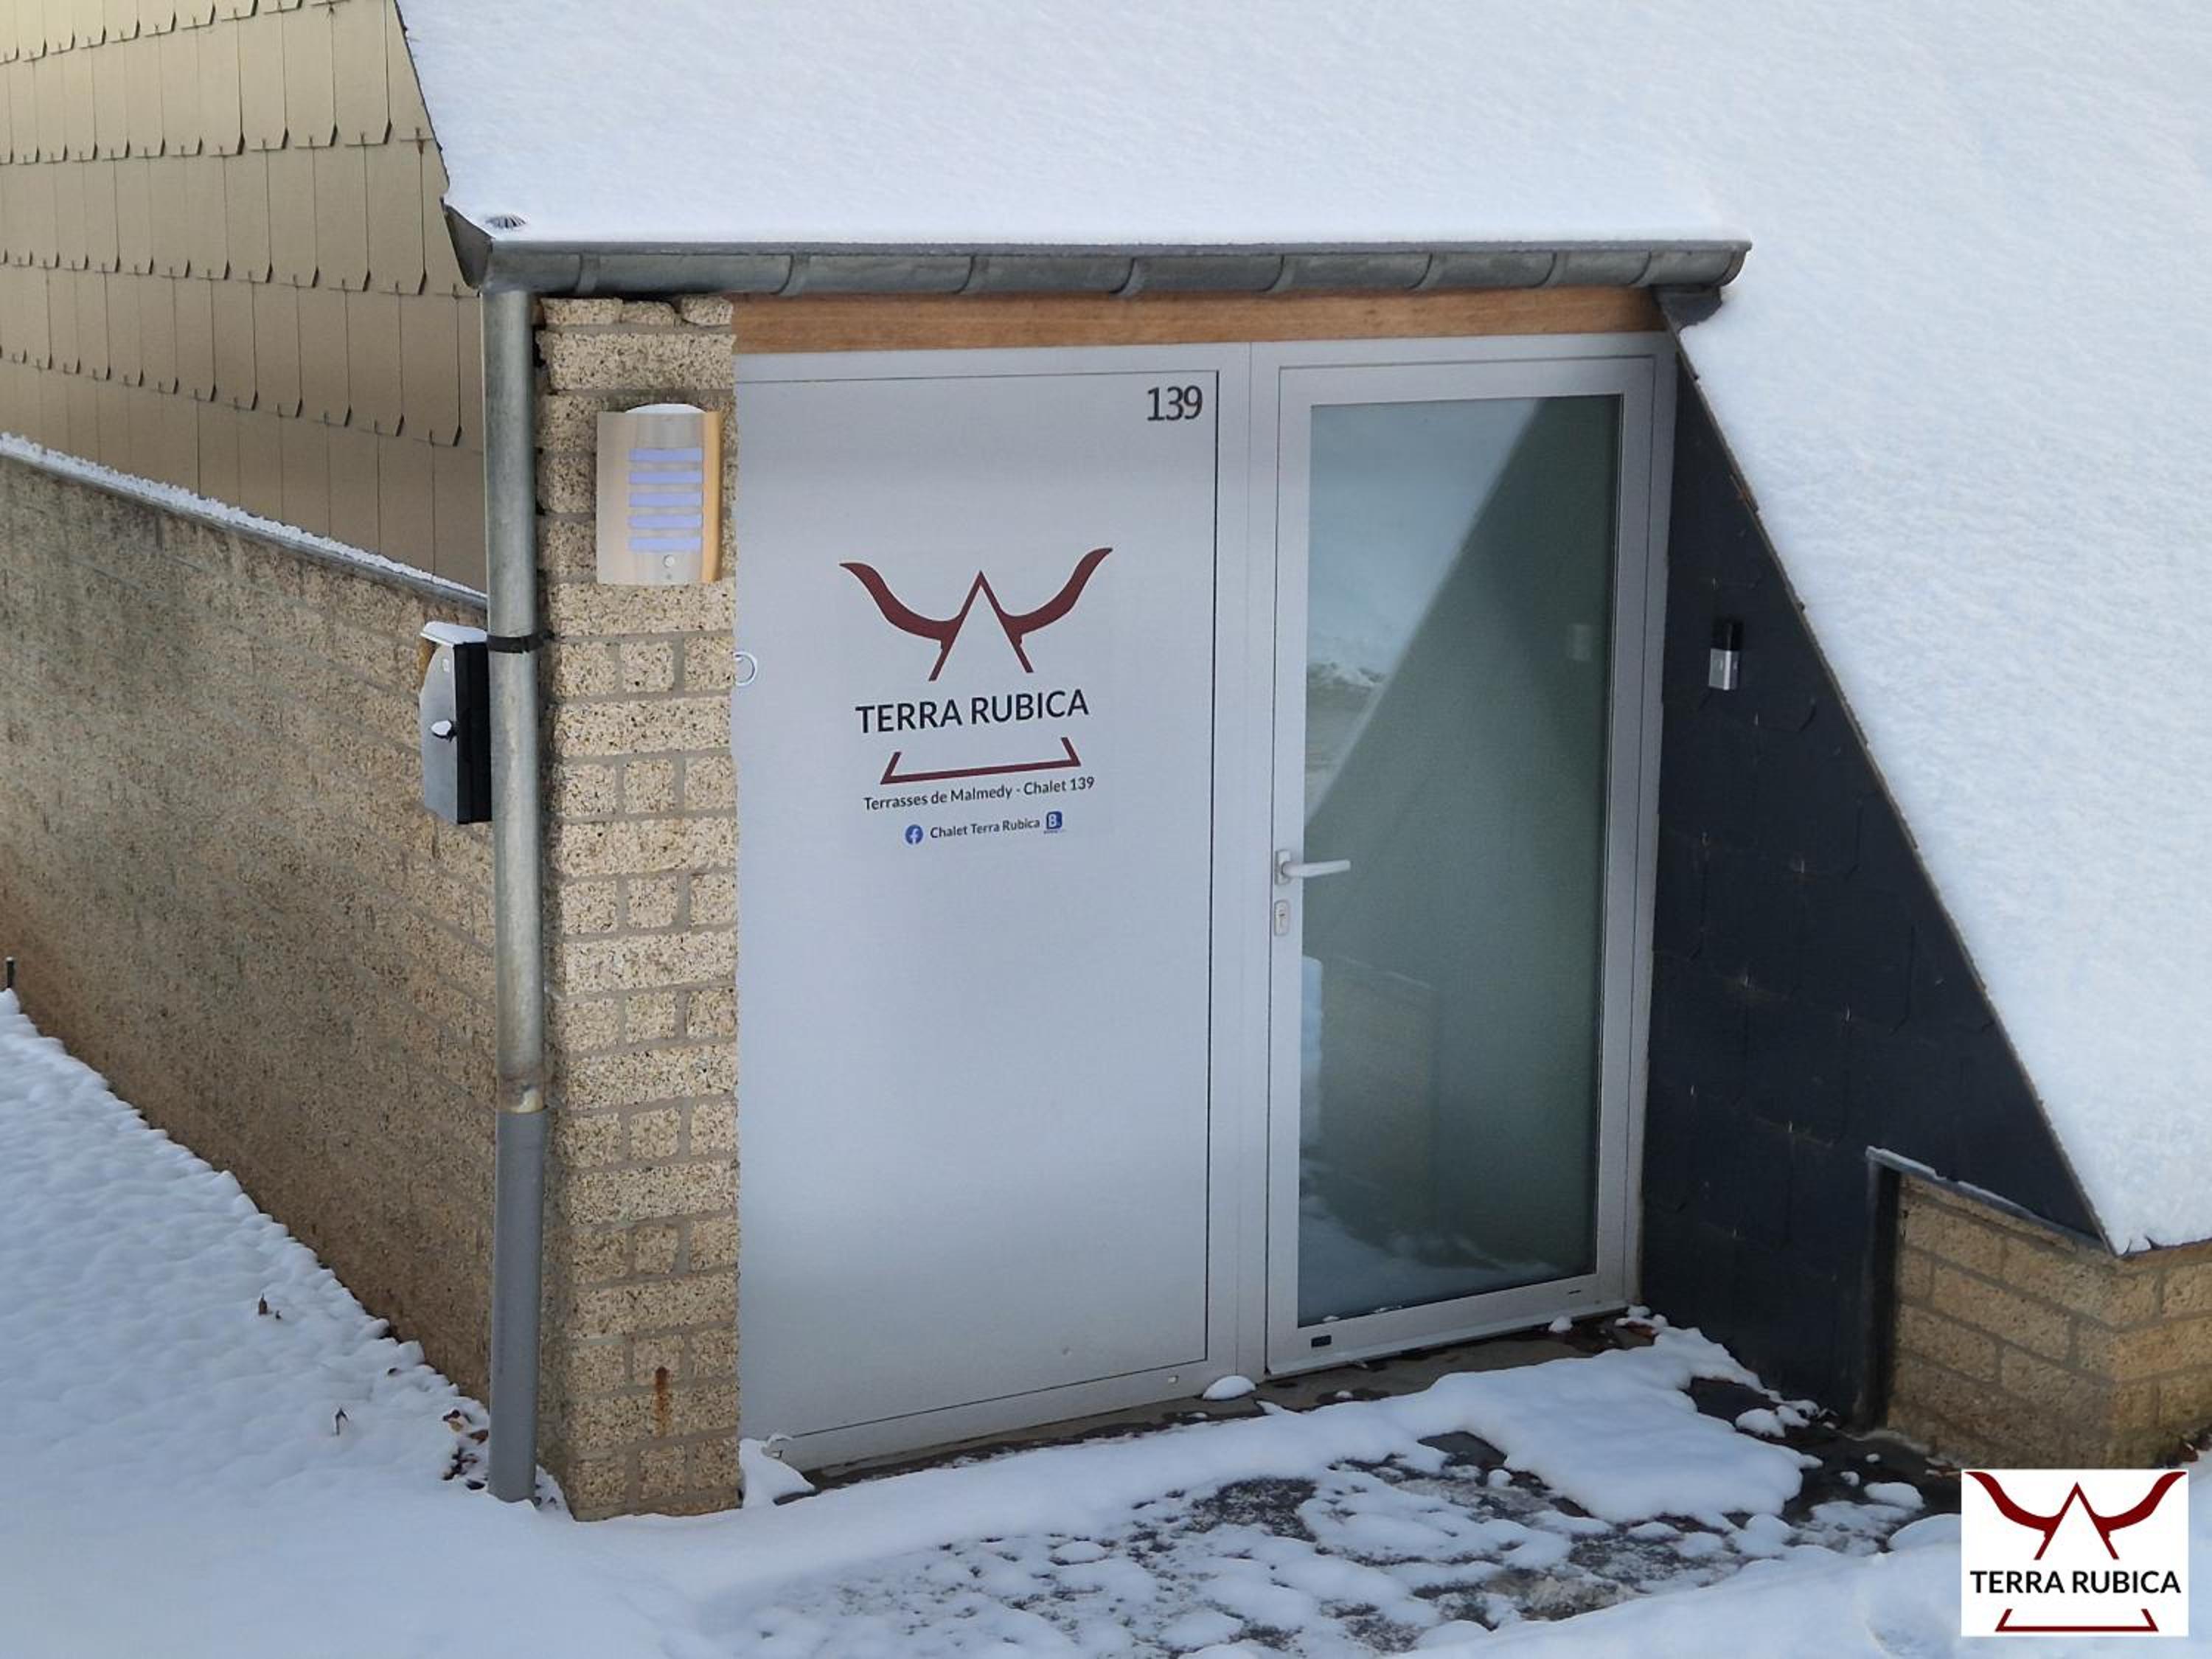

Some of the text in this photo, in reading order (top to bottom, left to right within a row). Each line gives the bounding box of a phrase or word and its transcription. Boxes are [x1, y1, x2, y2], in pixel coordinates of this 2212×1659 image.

[1147, 385, 1203, 421] 139
[855, 688, 1089, 734] TERRA RUBICA
[863, 796, 928, 811] Terrasses
[931, 790, 948, 804] de
[950, 785, 1012, 801] Malmedy
[1023, 781, 1067, 796] Chalet
[1070, 776, 1096, 792] 139
[930, 825, 967, 839] Chalet
[970, 822, 1001, 834] Terra
[1002, 818, 1040, 832] Rubica
